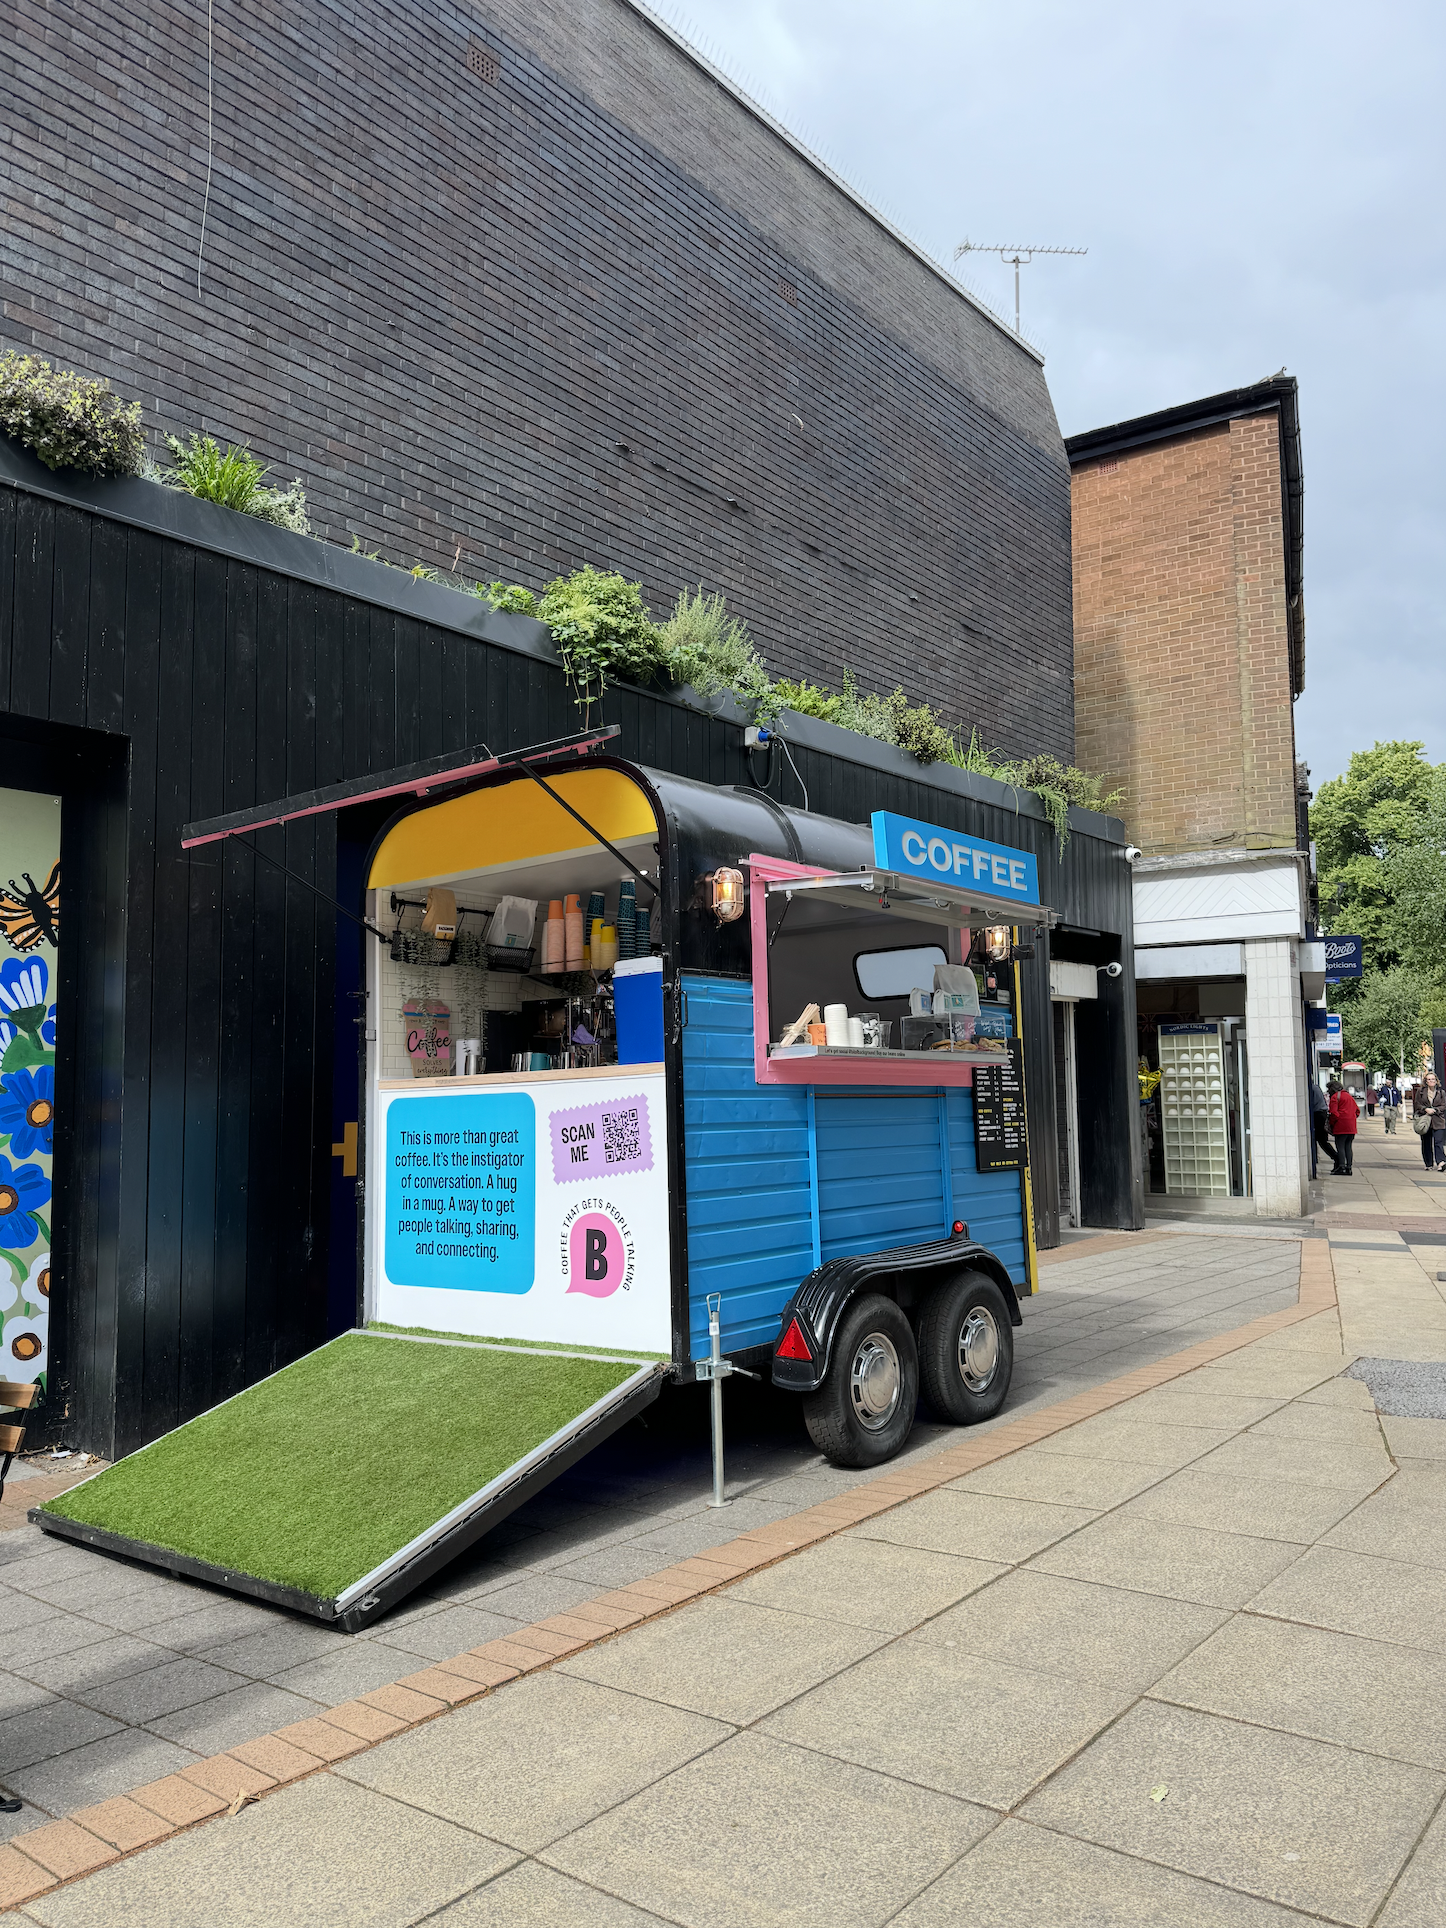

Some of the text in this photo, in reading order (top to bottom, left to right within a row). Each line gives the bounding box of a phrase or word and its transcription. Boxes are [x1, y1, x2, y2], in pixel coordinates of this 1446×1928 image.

[902, 831, 1027, 891] COFFEE
[1325, 942, 1357, 959] Boots
[1170, 1024, 1189, 1032] NORDIC
[401, 1129, 519, 1147] This is more than great
[561, 1123, 595, 1144] SCAN
[395, 1151, 524, 1170] coffee. It's the instigator
[571, 1145, 589, 1163] ME
[401, 1174, 517, 1193] of conversation. A hug
[403, 1196, 515, 1216] in a mug. A way to get
[399, 1218, 519, 1240] people talking, sharing,
[416, 1241, 499, 1262] and connecting.
[560, 1199, 635, 1291] COFFEE THAT GETS PEOPLE TALKING
[586, 1229, 608, 1280] B
